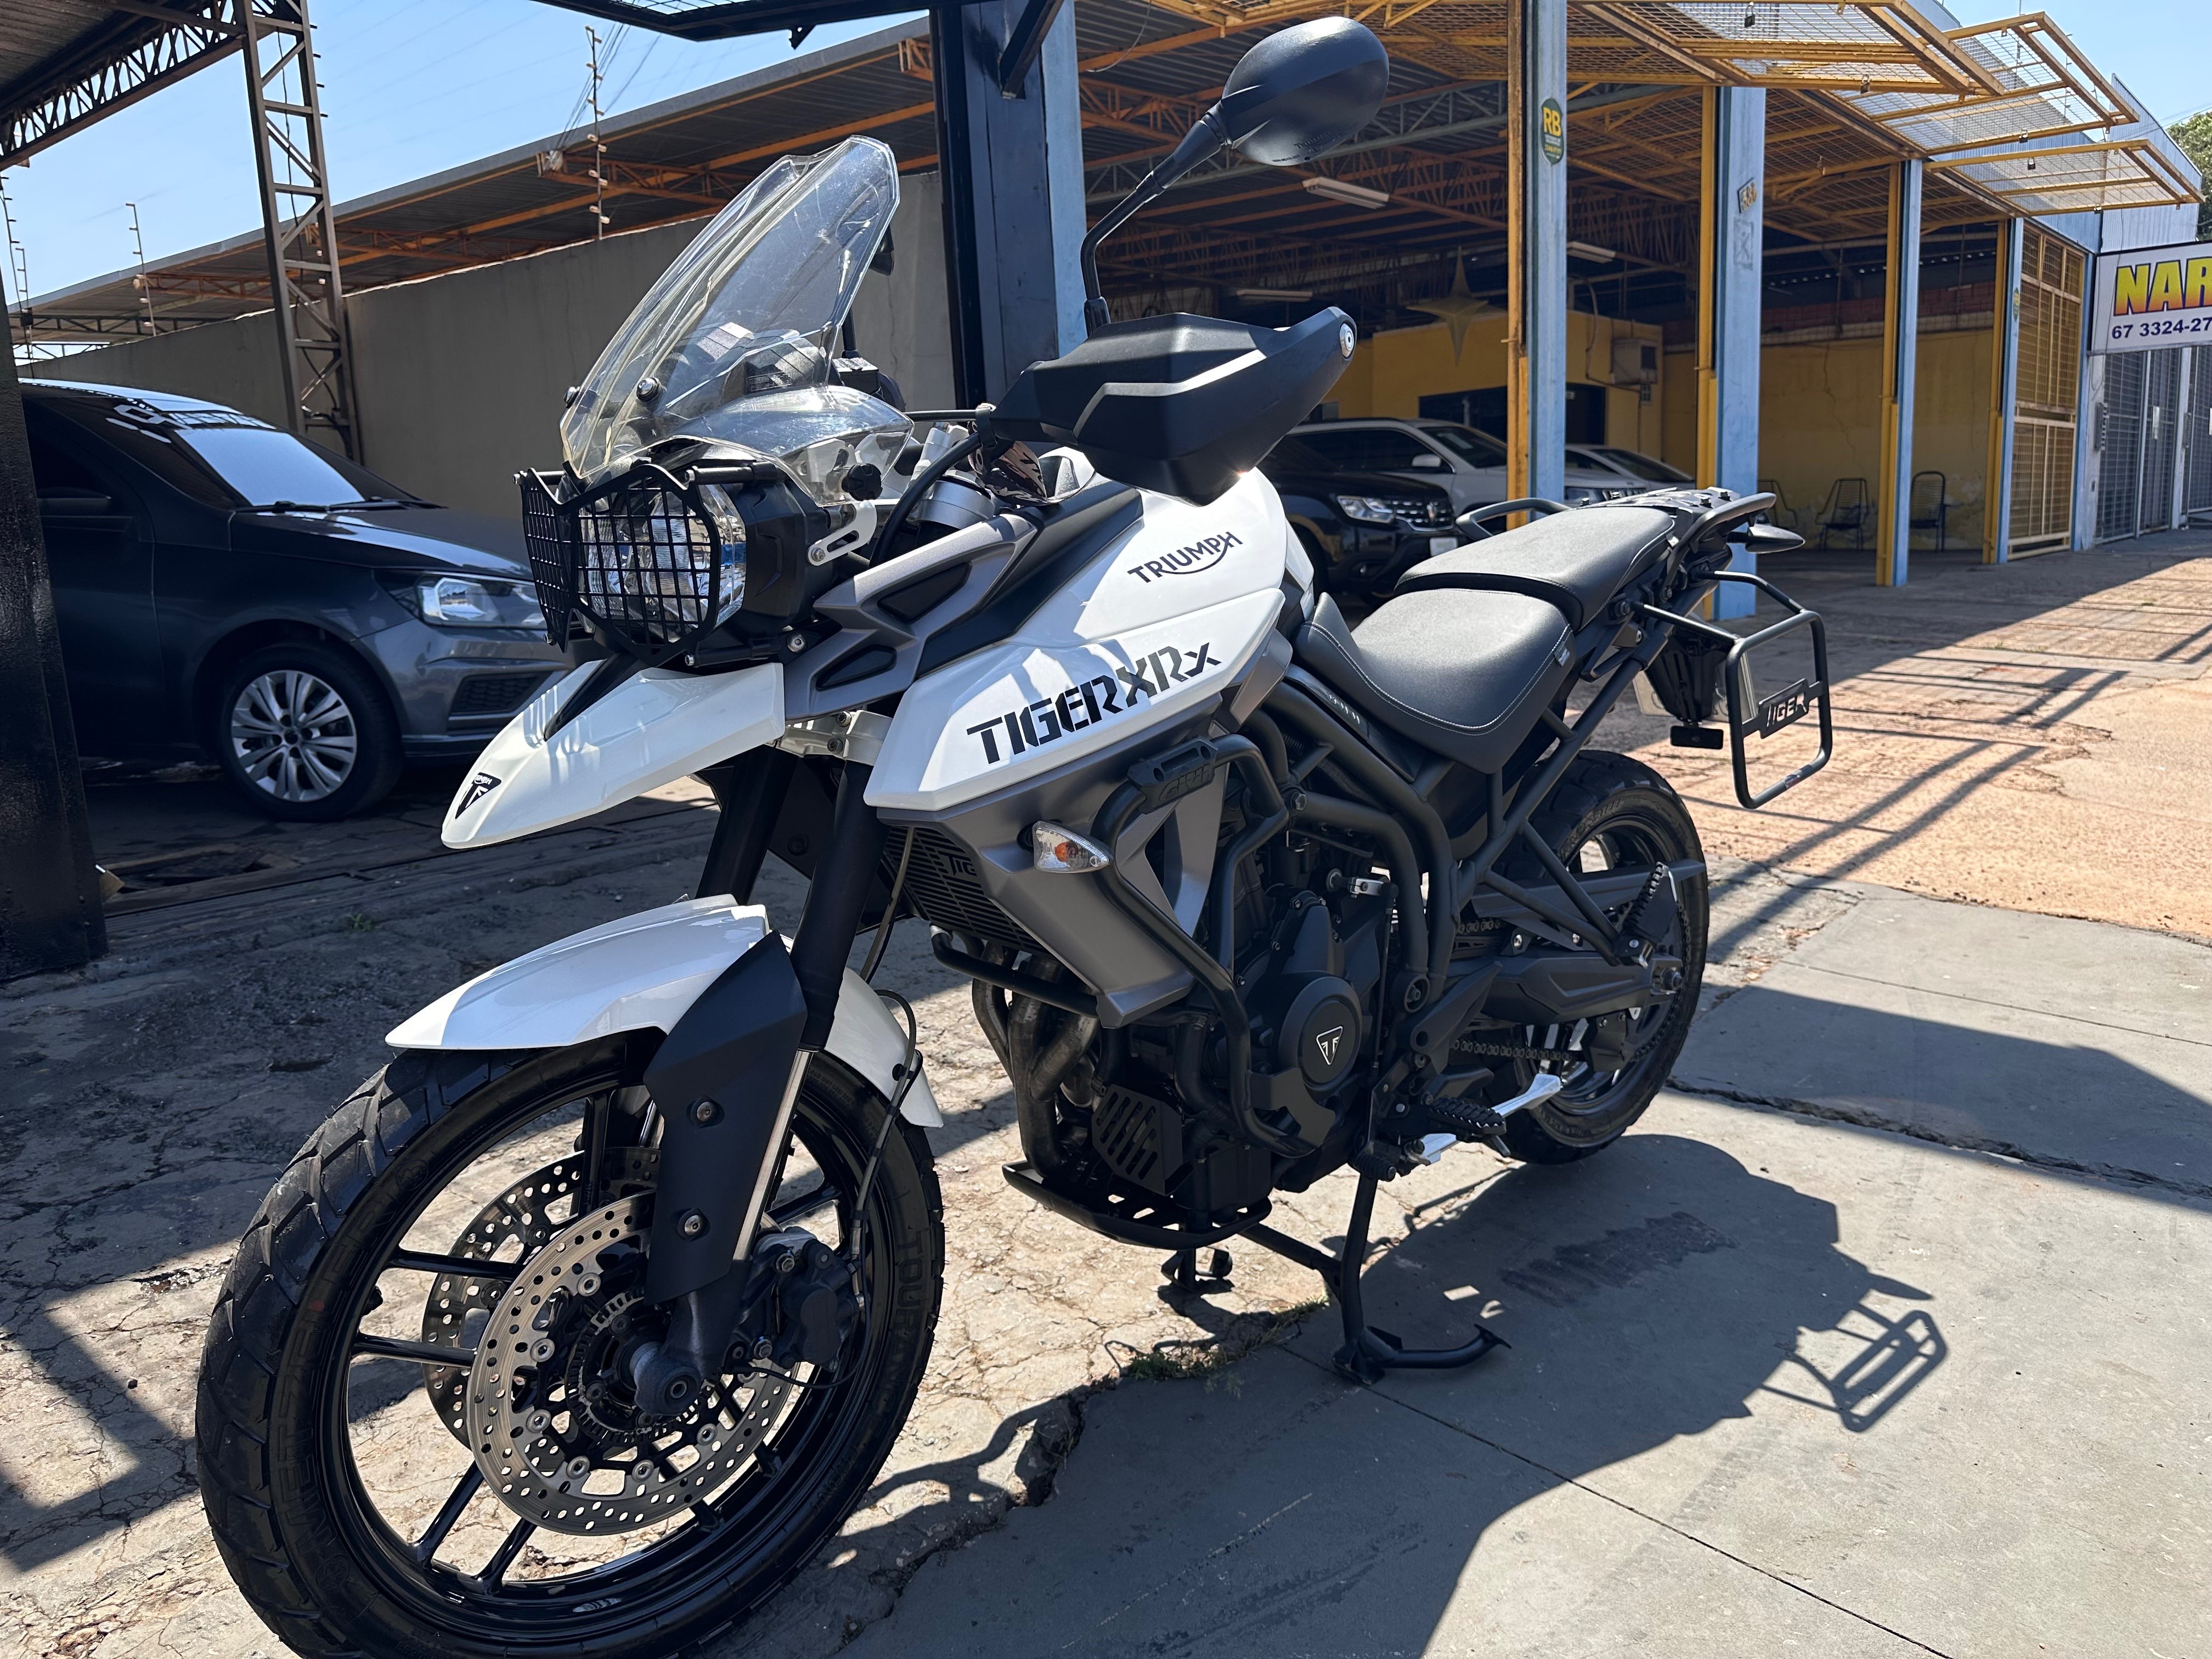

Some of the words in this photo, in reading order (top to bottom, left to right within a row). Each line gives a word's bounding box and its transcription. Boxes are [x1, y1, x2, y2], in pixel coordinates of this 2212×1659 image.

[1543, 107, 1562, 137] RB
[2112, 325, 2133, 339] 67
[1127, 531, 1243, 583] TRIUMPH
[1763, 691, 1807, 727] TIGER
